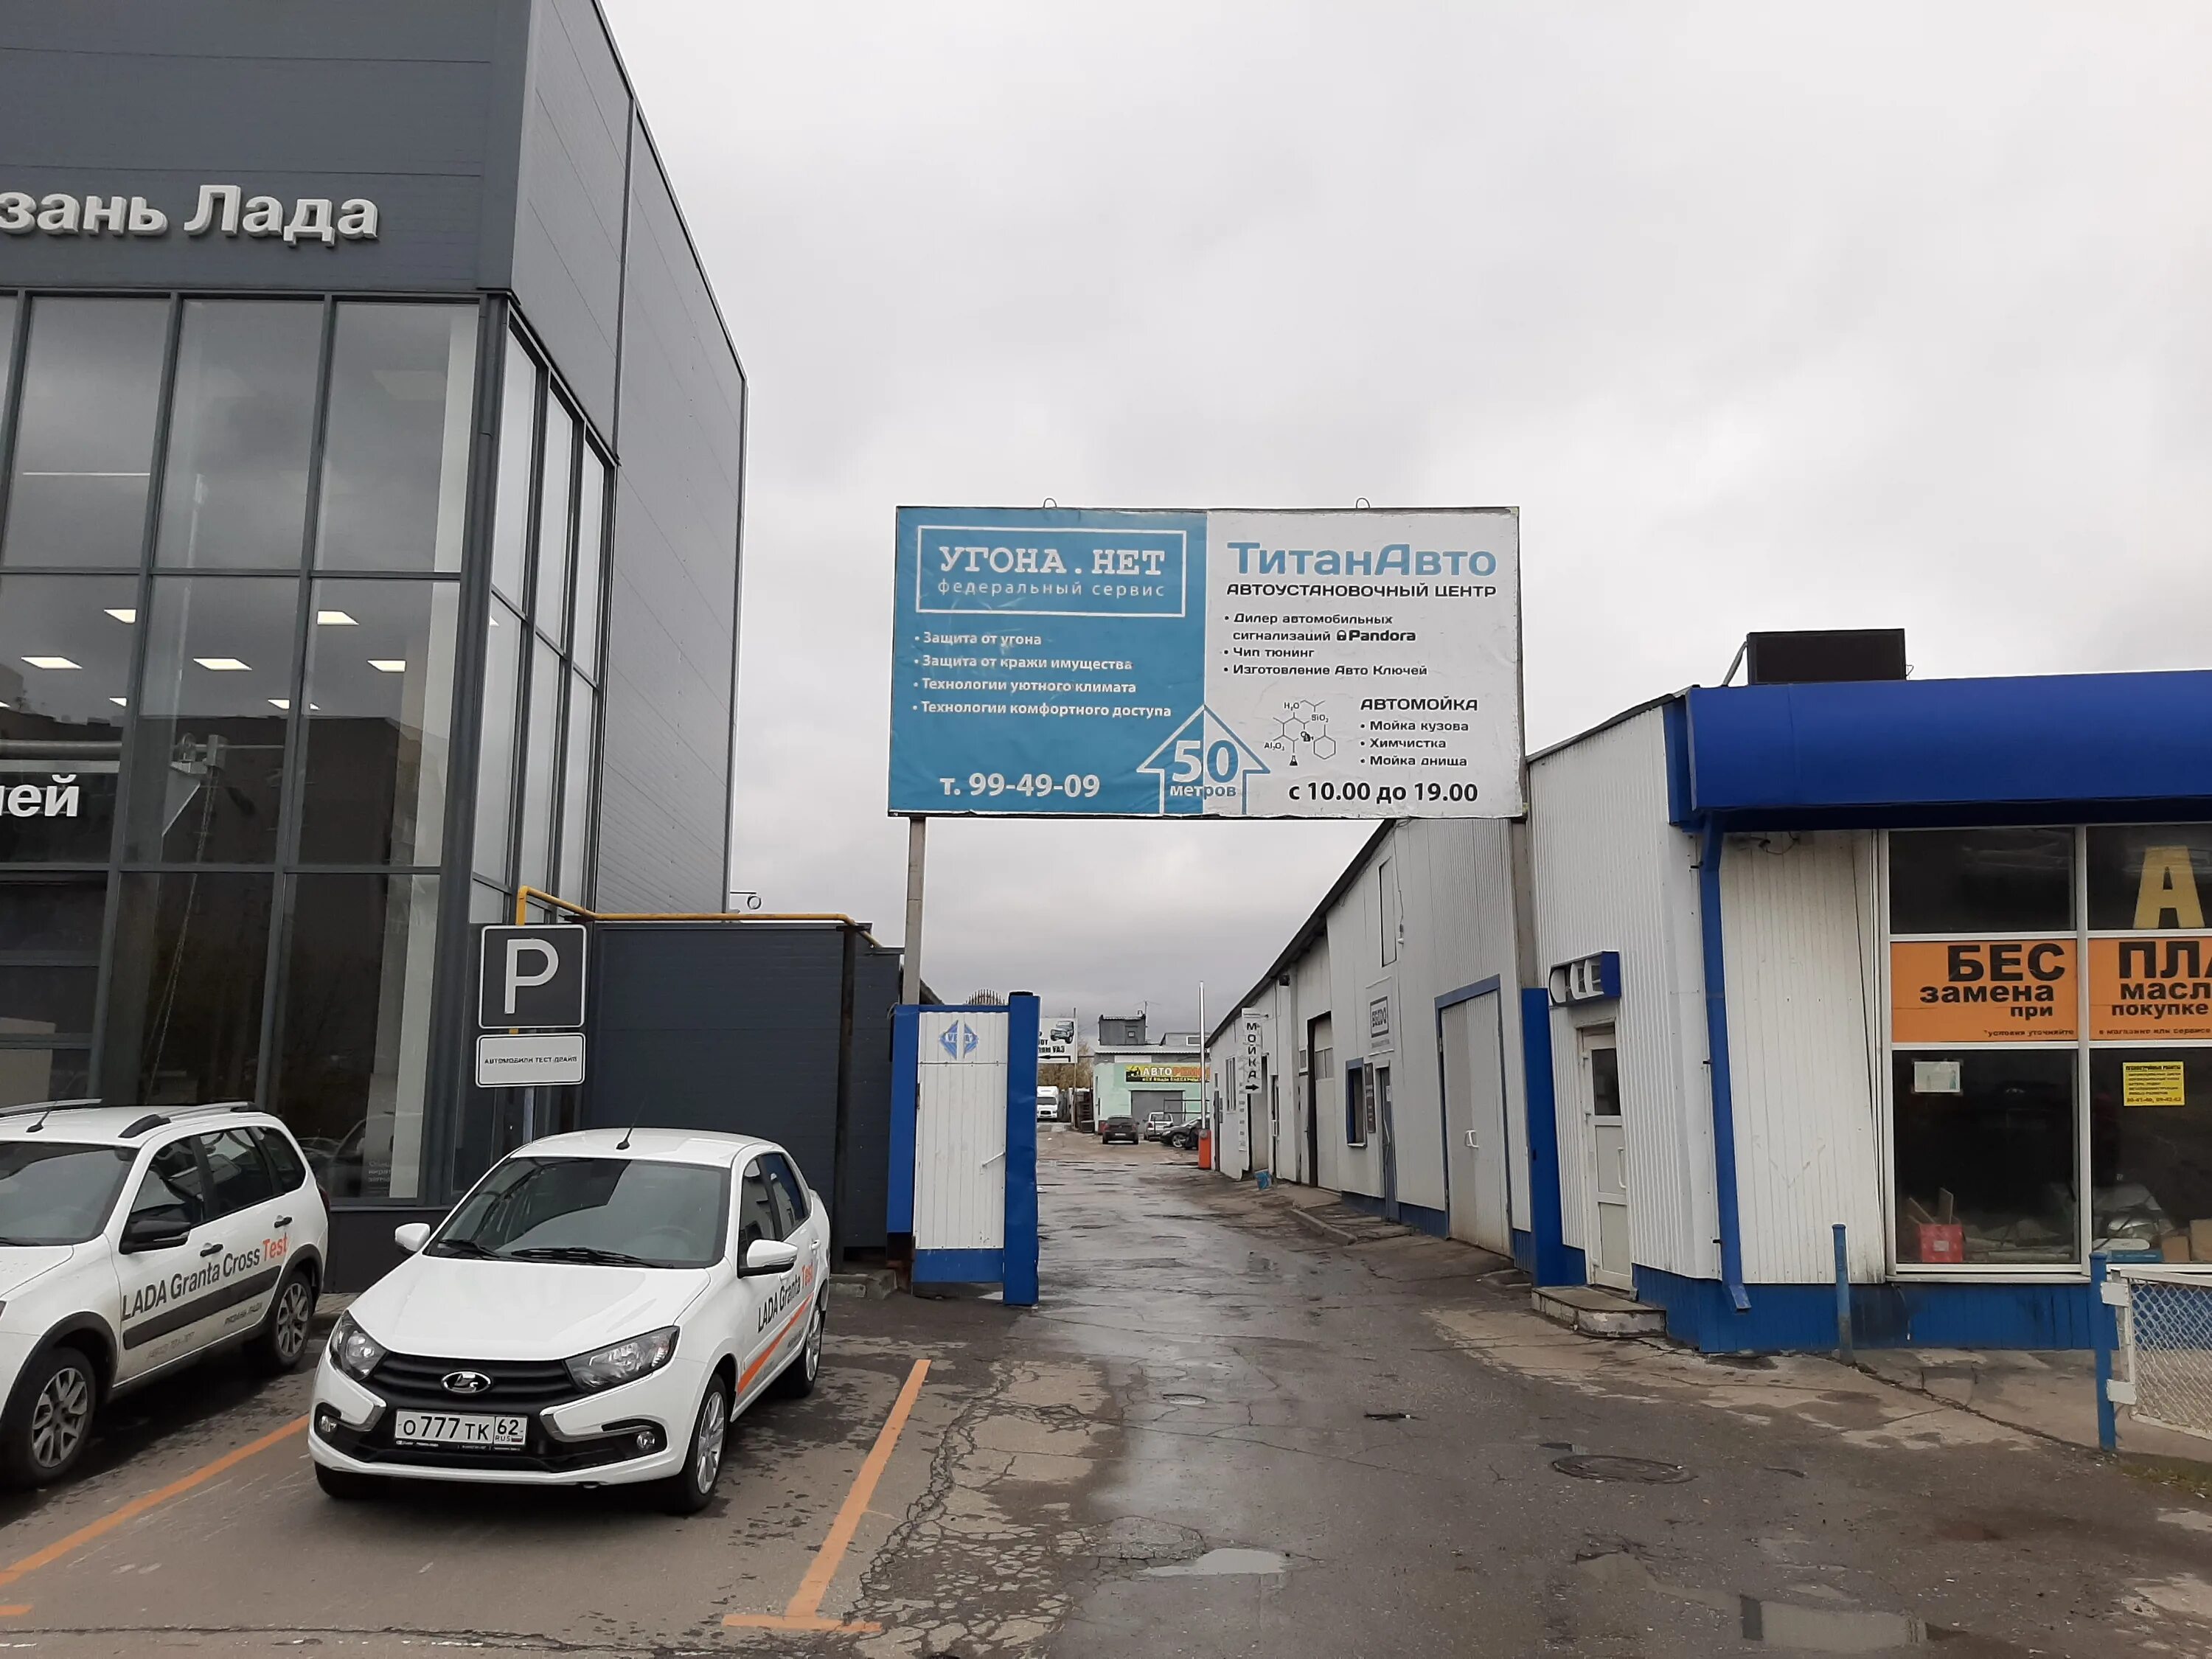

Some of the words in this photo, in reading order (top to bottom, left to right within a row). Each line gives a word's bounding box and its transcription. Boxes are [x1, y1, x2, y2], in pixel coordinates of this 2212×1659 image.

[0, 192, 169, 236] зань
[184, 184, 379, 246] Лада
[1227, 542, 1497, 577] ТитанАвто
[938, 579, 1082, 597] федеральный
[1093, 583, 1164, 599] сервис
[1226, 582, 1428, 598] АВТОУСТАНОВОЧНЫЙ
[1435, 585, 1497, 599] ЦЕНТР
[1234, 613, 1278, 625] Дилер
[1282, 614, 1393, 625] автомобильных
[923, 632, 978, 646] Защита
[981, 636, 998, 644] от
[1001, 636, 1042, 647] угона
[1233, 629, 1330, 641] сигнализаций
[1349, 630, 1416, 641] Pandora
[1233, 647, 1260, 658] Чип
[1265, 649, 1315, 658] тюнинг
[922, 655, 977, 668] Защита
[981, 658, 997, 667] от
[1001, 659, 1047, 670] кражи
[1051, 659, 1133, 672] имущества
[1233, 664, 1330, 675] Изготовление
[1335, 665, 1368, 675] Авто
[1373, 665, 1427, 676] Ключей
[922, 678, 1006, 690] Технологии
[1010, 681, 1071, 693] уютного
[1075, 683, 1136, 693] климата
[922, 701, 1006, 714] Технологии
[1010, 703, 1109, 717] комфортного
[1112, 706, 1172, 720] доступа
[1360, 696, 1478, 712] АВТОМОЙКА
[1370, 720, 1416, 732] Мойка
[1420, 722, 1470, 733] кузова
[1370, 737, 1447, 749] Химчистка
[1172, 739, 1239, 784] 50
[1370, 755, 1416, 767] Мойка
[1421, 757, 1467, 768] днища
[969, 773, 1101, 799] 99-49-09
[1170, 785, 1237, 800] метров
[1288, 786, 1300, 800] с
[1308, 782, 1371, 801] 10.00
[1376, 786, 1407, 804] до
[1414, 782, 1478, 802] 19.00
[0, 774, 80, 818] ей
[1947, 943, 2066, 982] БЕС
[2118, 940, 2212, 979] ПЛ
[504, 939, 559, 1015] P
[1919, 984, 2055, 1004] замена
[2011, 1006, 2053, 1020] при
[2112, 1003, 2209, 1020] покупке
[1246, 1022, 1257, 1079] МОЙКА
[122, 1279, 167, 1321] LADA
[170, 1262, 220, 1300] Granta
[223, 1248, 260, 1277] Cross
[262, 1233, 289, 1262] Test
[758, 1292, 778, 1333] LADA
[779, 1274, 801, 1312] Granta
[801, 1262, 814, 1289] Test
[497, 1419, 519, 1435] 62
